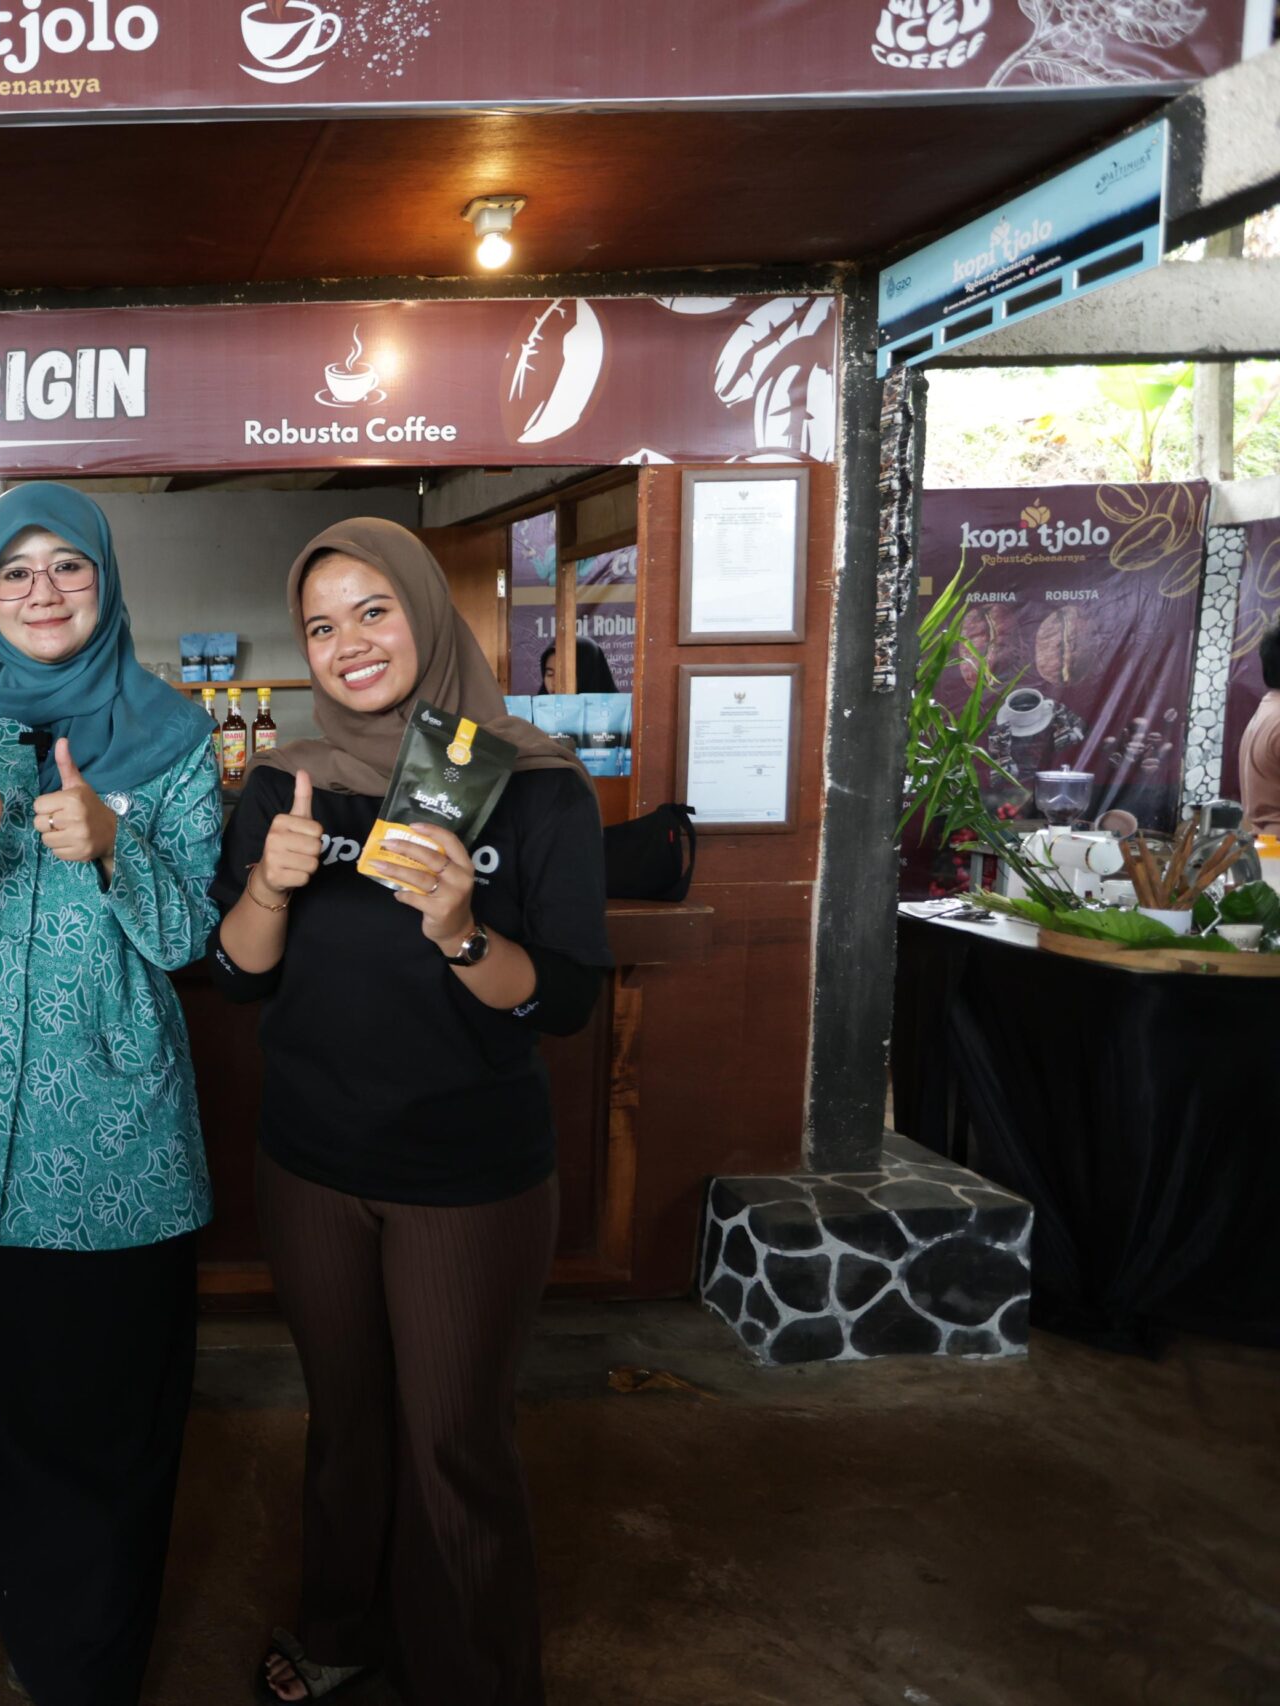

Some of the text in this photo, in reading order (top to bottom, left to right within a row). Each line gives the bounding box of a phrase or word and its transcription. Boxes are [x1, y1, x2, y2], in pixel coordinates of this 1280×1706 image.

[871, 31, 986, 69] COFFEE
[952, 244, 996, 283] kopi
[1002, 219, 1053, 262] tjolo
[244, 416, 457, 445] Robusta Coffee
[959, 518, 1111, 554] kopi tjolo
[965, 588, 1100, 602] ARABIKA ROBUSTA
[535, 616, 548, 639] 1.
[593, 614, 636, 637] Robu
[414, 790, 439, 806] kopi
[440, 799, 463, 818] tjolo
